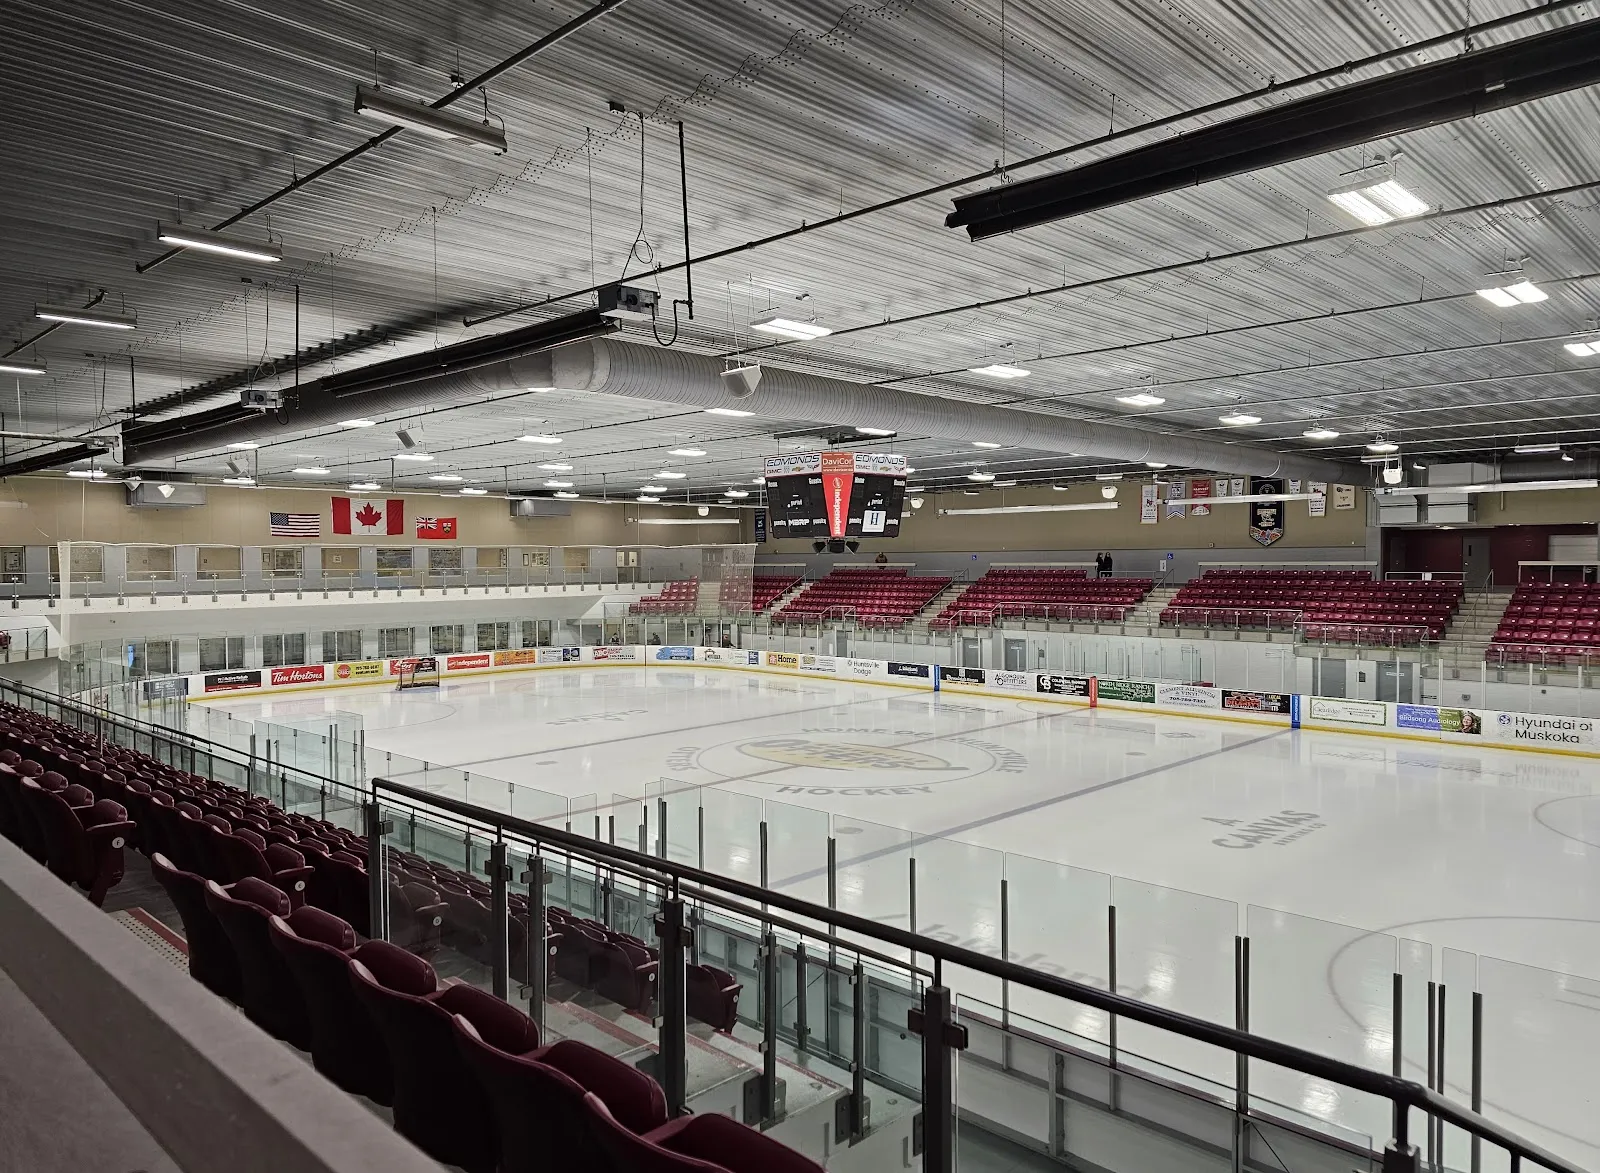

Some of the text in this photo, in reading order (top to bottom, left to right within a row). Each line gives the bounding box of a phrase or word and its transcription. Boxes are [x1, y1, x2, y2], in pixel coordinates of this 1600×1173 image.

[767, 454, 820, 467] EDMONDS
[823, 457, 852, 465] DaviCor
[855, 454, 905, 466] EDMONDS
[833, 488, 843, 535] Independent
[456, 658, 489, 667] Independent
[777, 654, 797, 664] Home
[272, 671, 289, 683] Tim
[290, 669, 323, 681] Hortons
[853, 667, 872, 677] Dodge
[1399, 714, 1461, 726] Birdsong Audiology
[1515, 716, 1575, 730] Hyundai
[1515, 729, 1580, 744] Muskoka
[665, 746, 702, 772] OTTERS
[776, 786, 936, 797] HOCKEY
[1211, 810, 1321, 850] CANVAS
